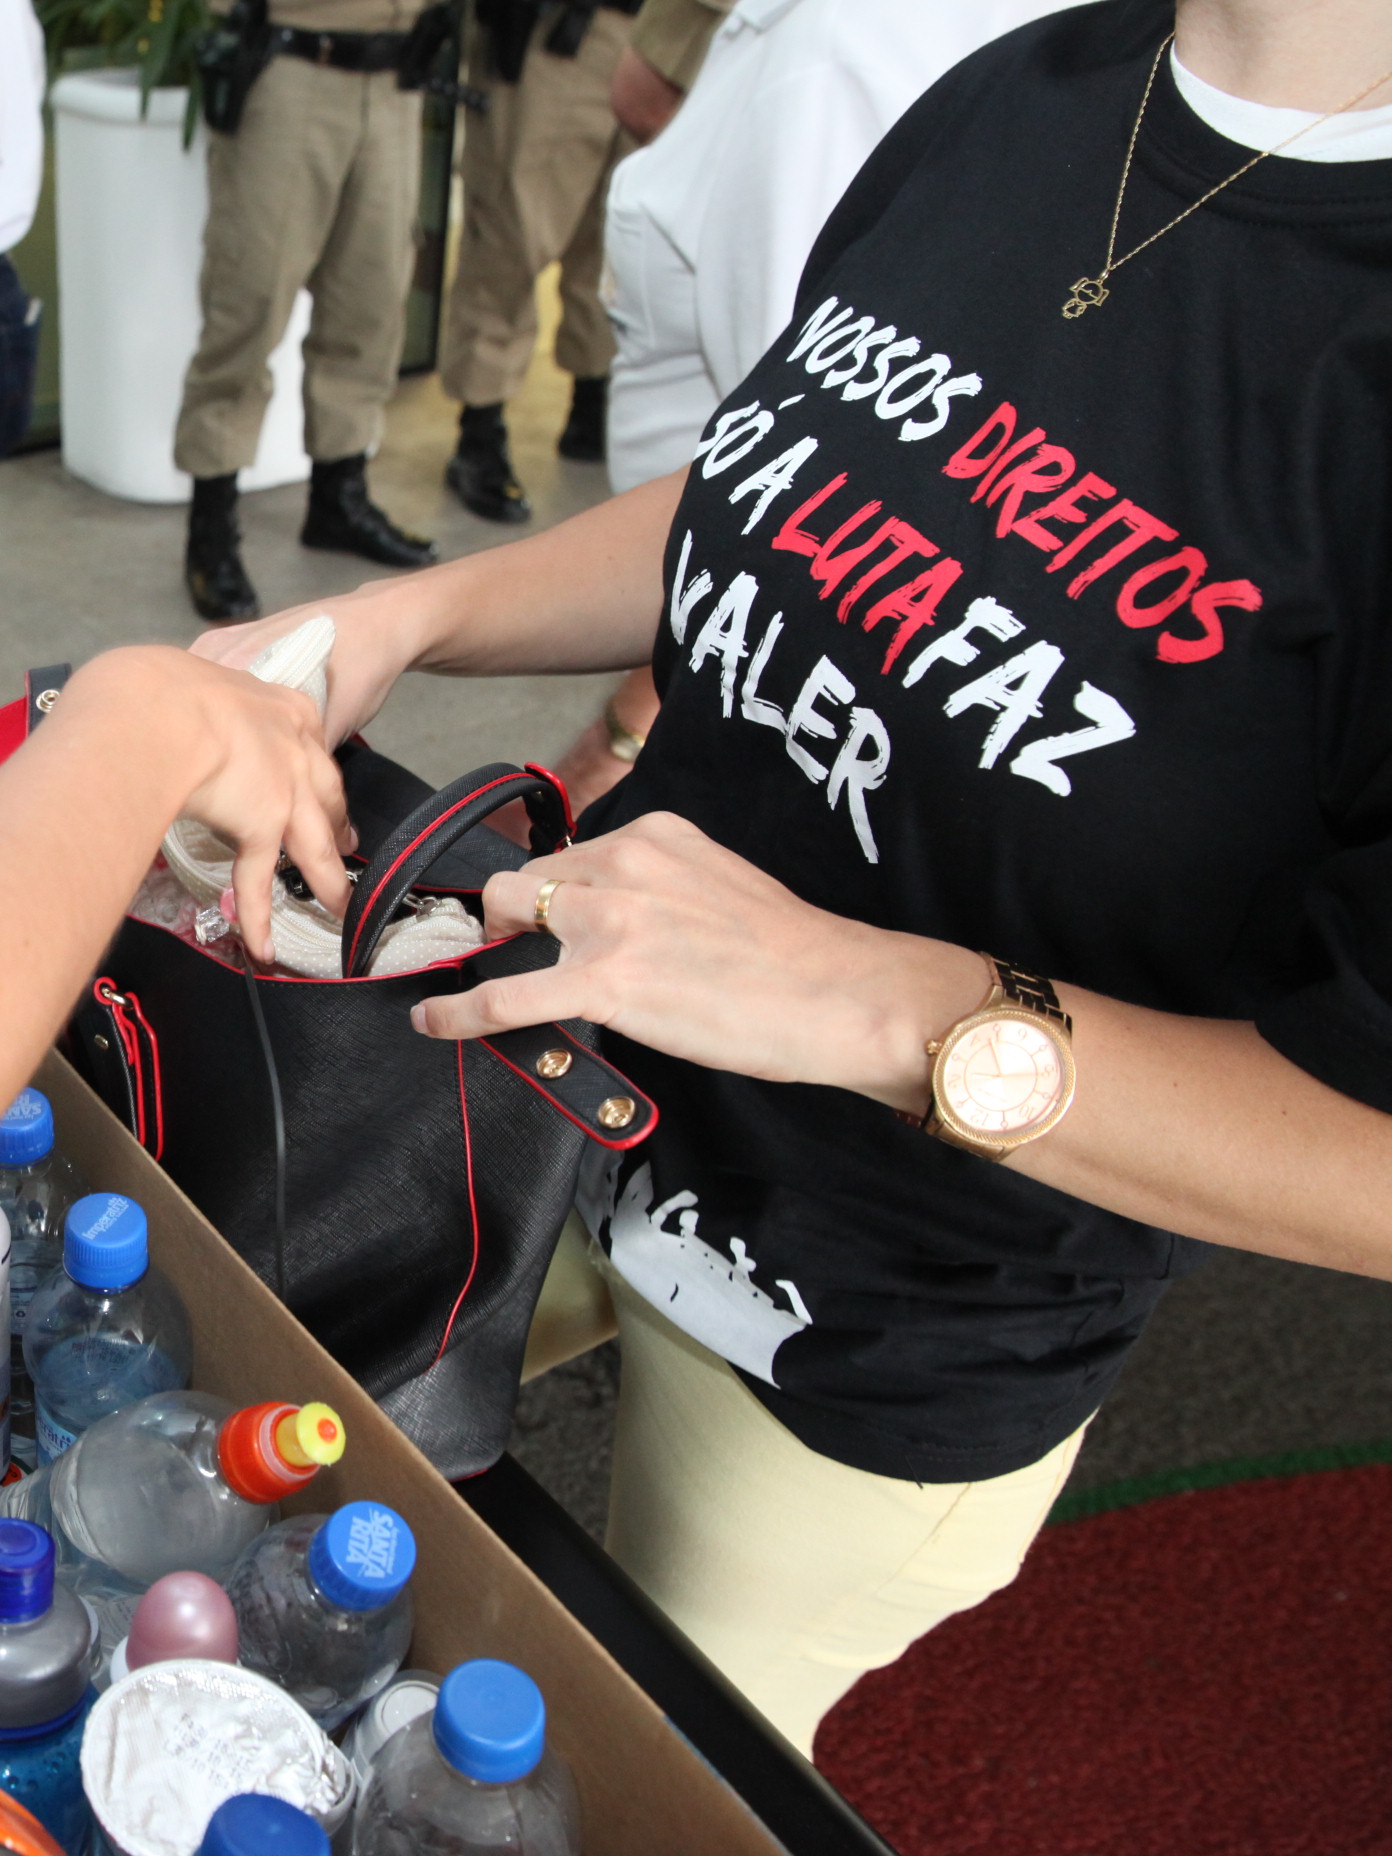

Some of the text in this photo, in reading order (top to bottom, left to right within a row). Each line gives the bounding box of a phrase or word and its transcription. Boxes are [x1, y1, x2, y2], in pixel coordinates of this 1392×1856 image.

[786, 296, 1263, 663] NOSSOS DIREITOS
[693, 393, 1136, 796] SÓ A LUTA FAZ
[669, 529, 891, 863] VALER
[81, 1197, 128, 1241] Imperatriz
[346, 1516, 371, 1563] RITA
[363, 1510, 394, 1579] SANTA
